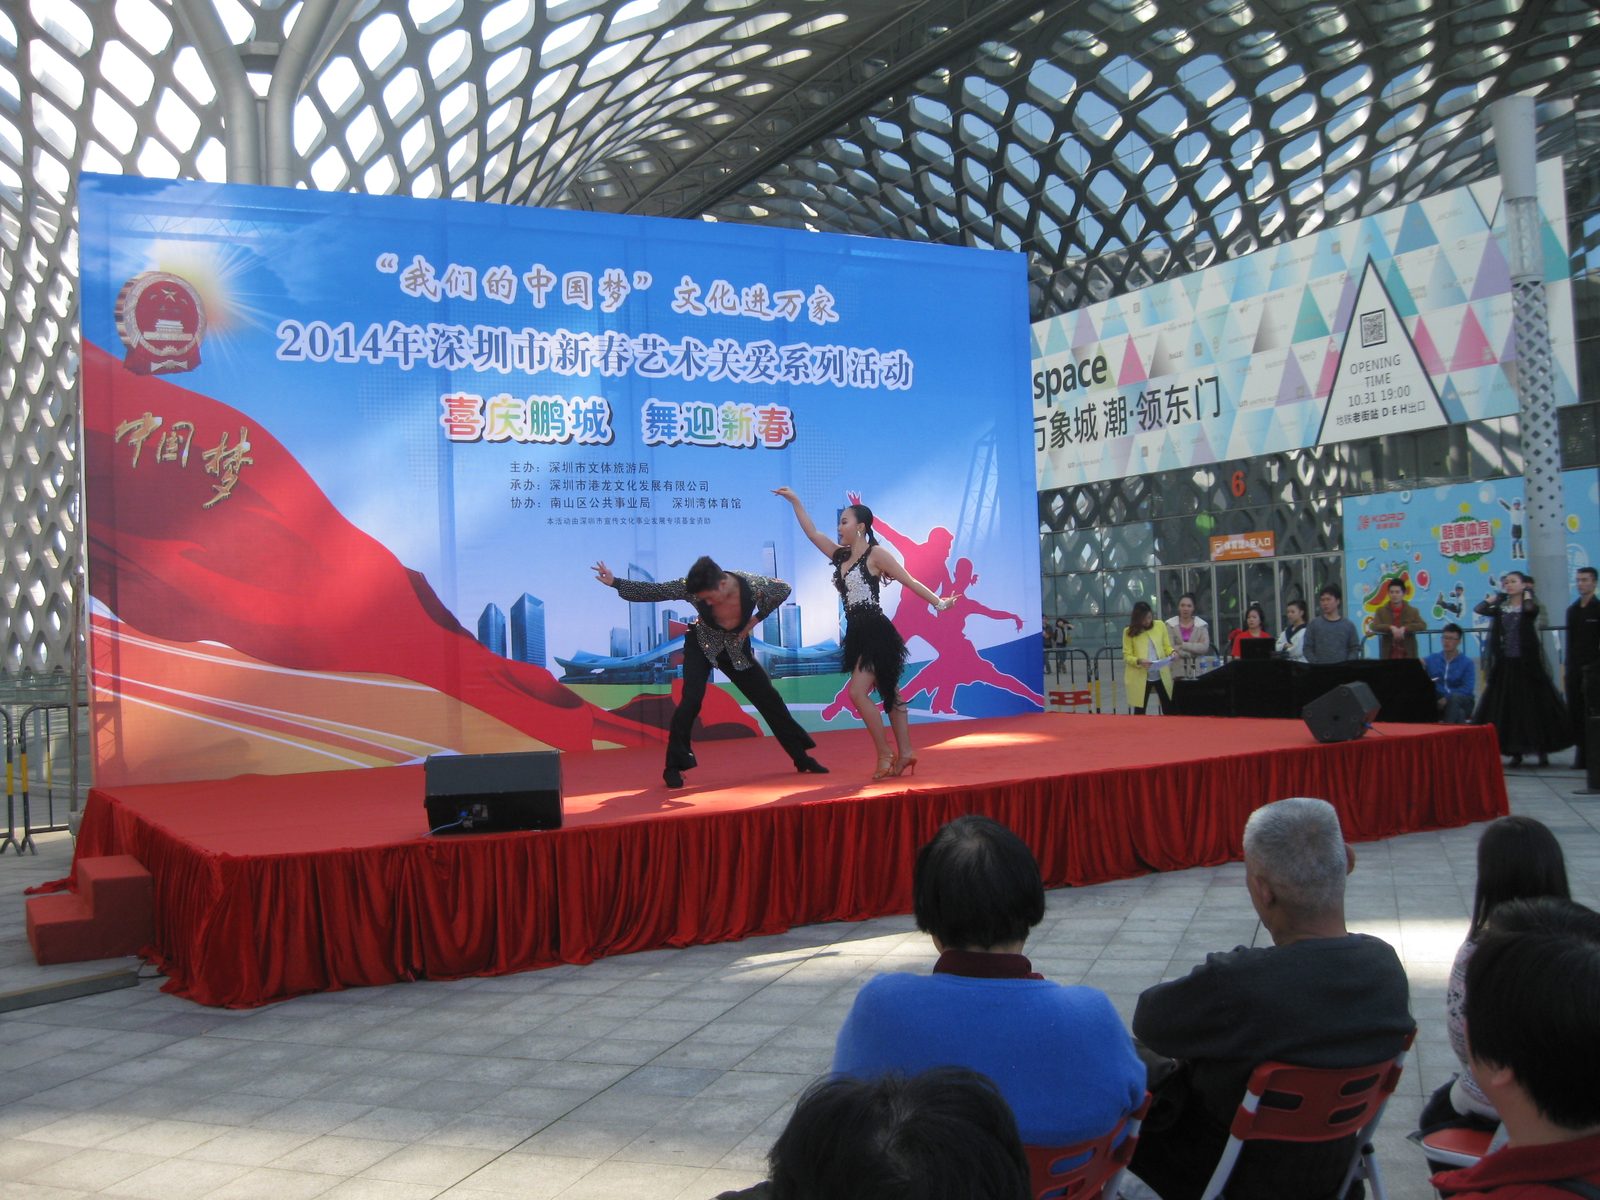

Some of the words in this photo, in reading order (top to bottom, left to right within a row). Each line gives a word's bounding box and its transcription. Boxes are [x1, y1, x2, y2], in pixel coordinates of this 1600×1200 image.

[673, 275, 838, 324] 文化进万家
[278, 320, 912, 388] 2014年深圳市新春艺术关爱系列活动
[1350, 354, 1401, 375] OPENING
[1033, 354, 1107, 408] space
[1364, 372, 1391, 387] TIME
[1348, 392, 1377, 407] 10.31
[1381, 385, 1411, 401] 19:00
[441, 394, 611, 442] 喜庆鹏城
[643, 399, 793, 446] 舞迎新春
[115, 412, 253, 508] 中国梦
[549, 461, 649, 474] 深圳市文体旅游局
[549, 479, 709, 492] 深圳市港龙文化发展有限公司
[1231, 471, 1246, 497] 6
[550, 497, 651, 509] 南山区公共事业局
[672, 497, 742, 510] 深圳湾体育馆
